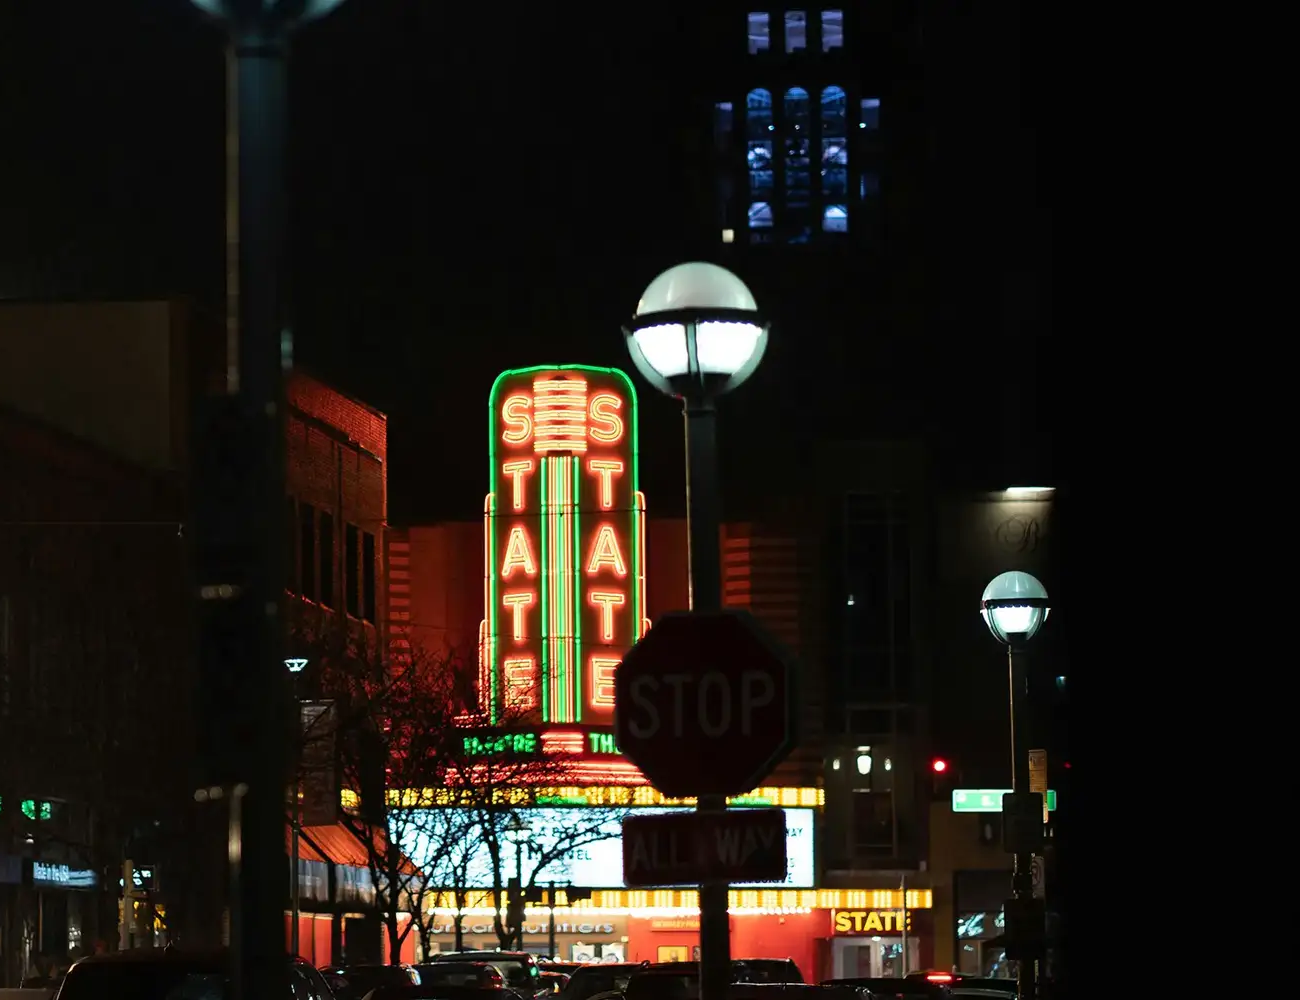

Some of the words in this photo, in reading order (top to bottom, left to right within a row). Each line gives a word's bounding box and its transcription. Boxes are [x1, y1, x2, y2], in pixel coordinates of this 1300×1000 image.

[502, 395, 535, 708] STATE
[588, 394, 626, 707] STATE
[628, 668, 775, 739] STOP
[528, 844, 592, 861] MVEL
[629, 828, 689, 873] ALL
[713, 824, 779, 868] WAY
[835, 911, 911, 932] STATE
